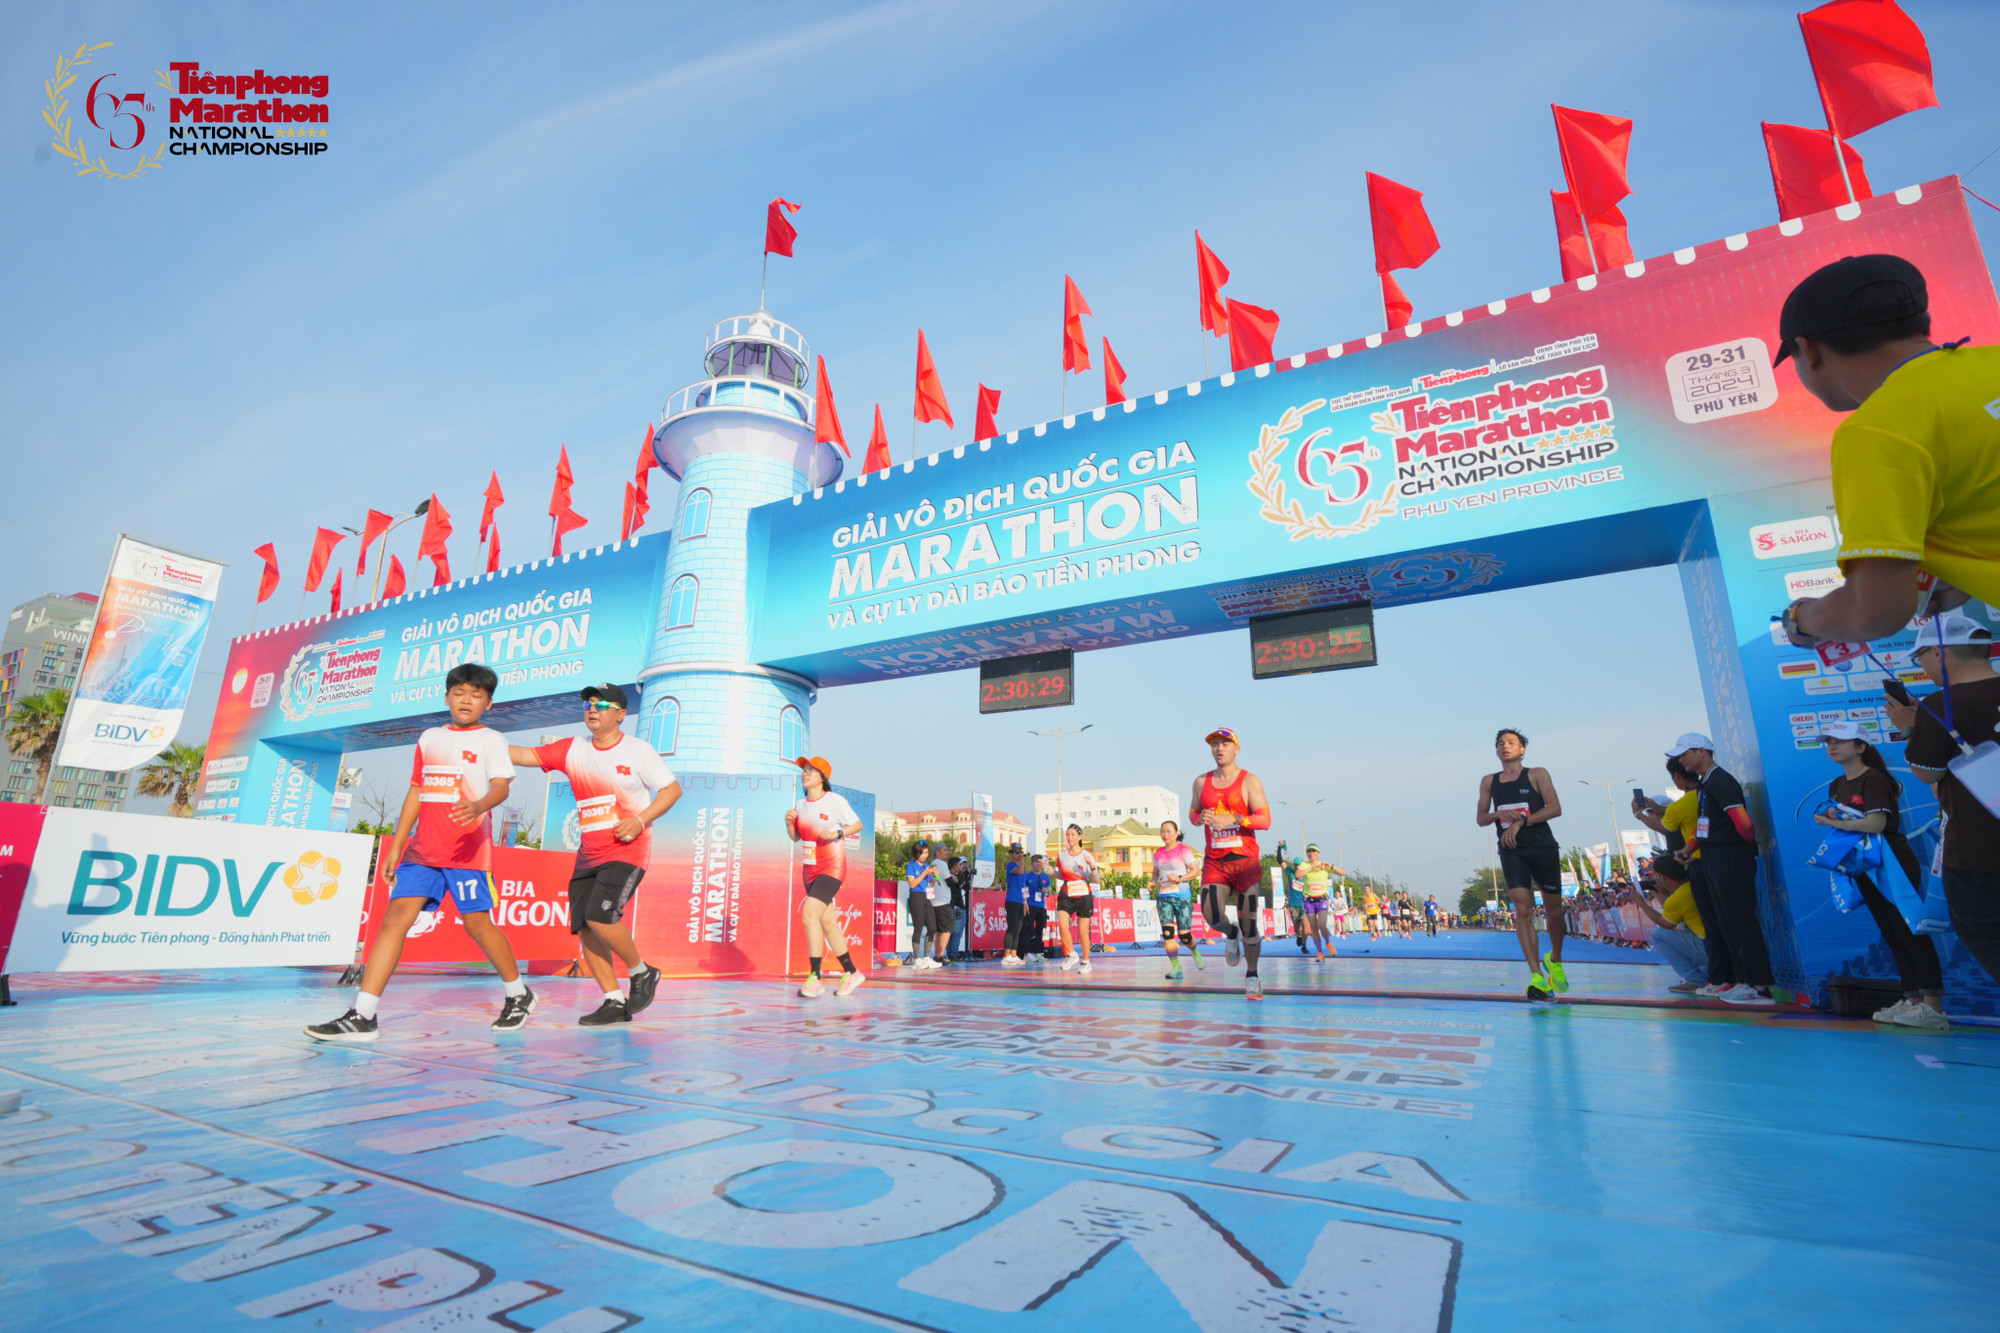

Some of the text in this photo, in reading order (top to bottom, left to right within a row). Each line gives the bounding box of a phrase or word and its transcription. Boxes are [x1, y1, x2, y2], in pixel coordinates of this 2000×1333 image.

[1685, 346, 1747, 372] 29-31
[1688, 365, 1750, 386] THÁNG 3
[1690, 375, 1754, 398] 2024
[1693, 391, 1758, 415] PHÚ YÊN
[1394, 399, 1609, 464] Marathon
[1398, 441, 1536, 480] NATIONAL
[1400, 441, 1616, 496] CHAMPIONSHIP
[832, 440, 1197, 549] GIẢI VÔ ĐỊCH QUỐC GIA
[1403, 467, 1622, 519] PHU YEN PROVINCE
[828, 475, 1200, 600] MARATHON
[1780, 531, 1827, 545] SAIGON
[1838, 547, 1921, 560] MARATHON
[827, 540, 1202, 630] VÀ CỰ LY DÀI BÁO TIỀN PHONG
[1790, 577, 1835, 589] HDBank
[115, 592, 200, 620] MARATHON
[401, 617, 433, 643] GIẢI
[436, 612, 460, 635] VÔ
[462, 606, 502, 632] ĐỊCH
[504, 589, 556, 621] QUỐC
[558, 587, 593, 609] GIA
[393, 613, 591, 681] MARATHON
[857, 608, 1178, 671] MARATHON
[1255, 631, 1364, 665] 2:30:25
[1835, 642, 1850, 656] 3
[321, 664, 378, 686] Marathon
[390, 659, 584, 704] VÀ CỰ LY TIỀN PHONG
[982, 674, 1065, 704] 2:30:29
[317, 686, 373, 704] CHAMPIONSHIP
[94, 723, 148, 742] BIDV
[280, 759, 308, 831] RATHON
[581, 805, 611, 819] 50367
[735, 808, 744, 840] PHONG
[731, 841, 743, 861] TIỀN
[66, 849, 286, 917] BIDV
[686, 807, 708, 943] GIẢI VÔ ĐỊCH QUỐC GIA
[704, 807, 731, 943] MARATHON
[731, 862, 741, 882] BÁO
[456, 878, 479, 901] 17
[500, 879, 536, 897] BIA
[730, 883, 740, 899] DÀI
[455, 899, 570, 927] IGON
[730, 900, 739, 912] LY
[60, 931, 99, 946] Vững
[102, 931, 137, 944] bước
[170, 931, 210, 946] phong
[219, 930, 250, 946] Đồng
[251, 930, 279, 943] hành
[280, 930, 306, 943] Phát
[307, 929, 331, 943] triển
[728, 928, 738, 942] VÀ
[1112, 918, 1134, 930] SAIGON
[955, 1058, 1474, 1120] PROVINCE
[1061, 1122, 1472, 1202] GIA
